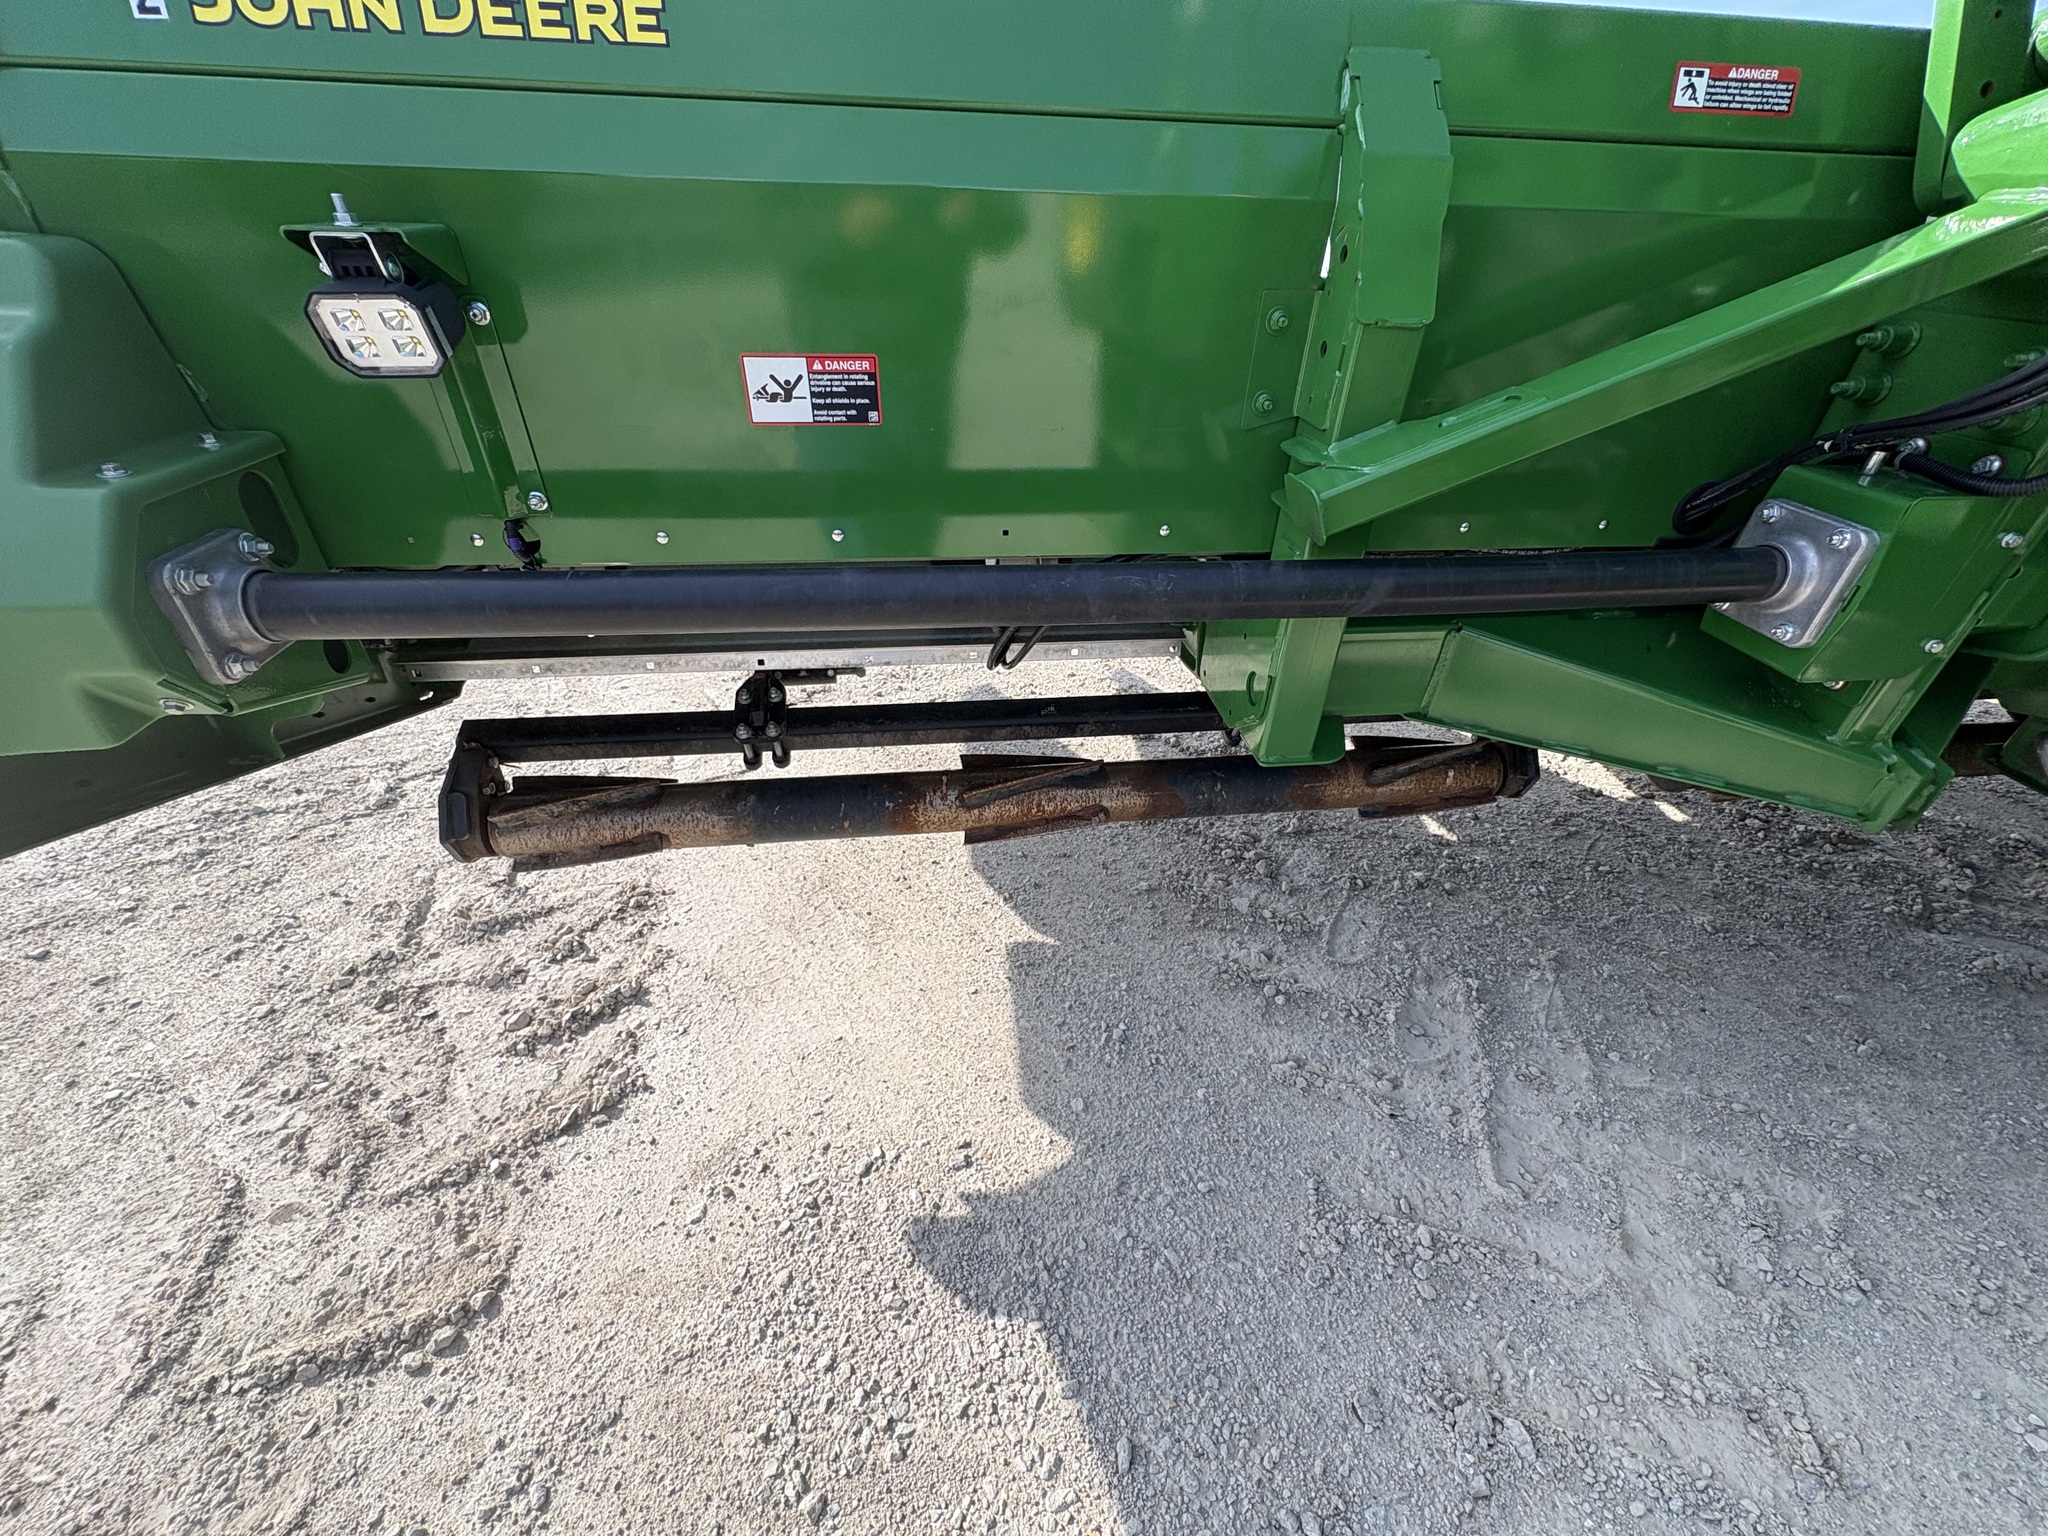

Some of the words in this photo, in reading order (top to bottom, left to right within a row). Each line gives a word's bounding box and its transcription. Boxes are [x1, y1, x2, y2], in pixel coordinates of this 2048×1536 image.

[419, 0, 669, 47] DEERE
[1737, 68, 1779, 80] DANGER
[824, 360, 870, 371] DANGER
